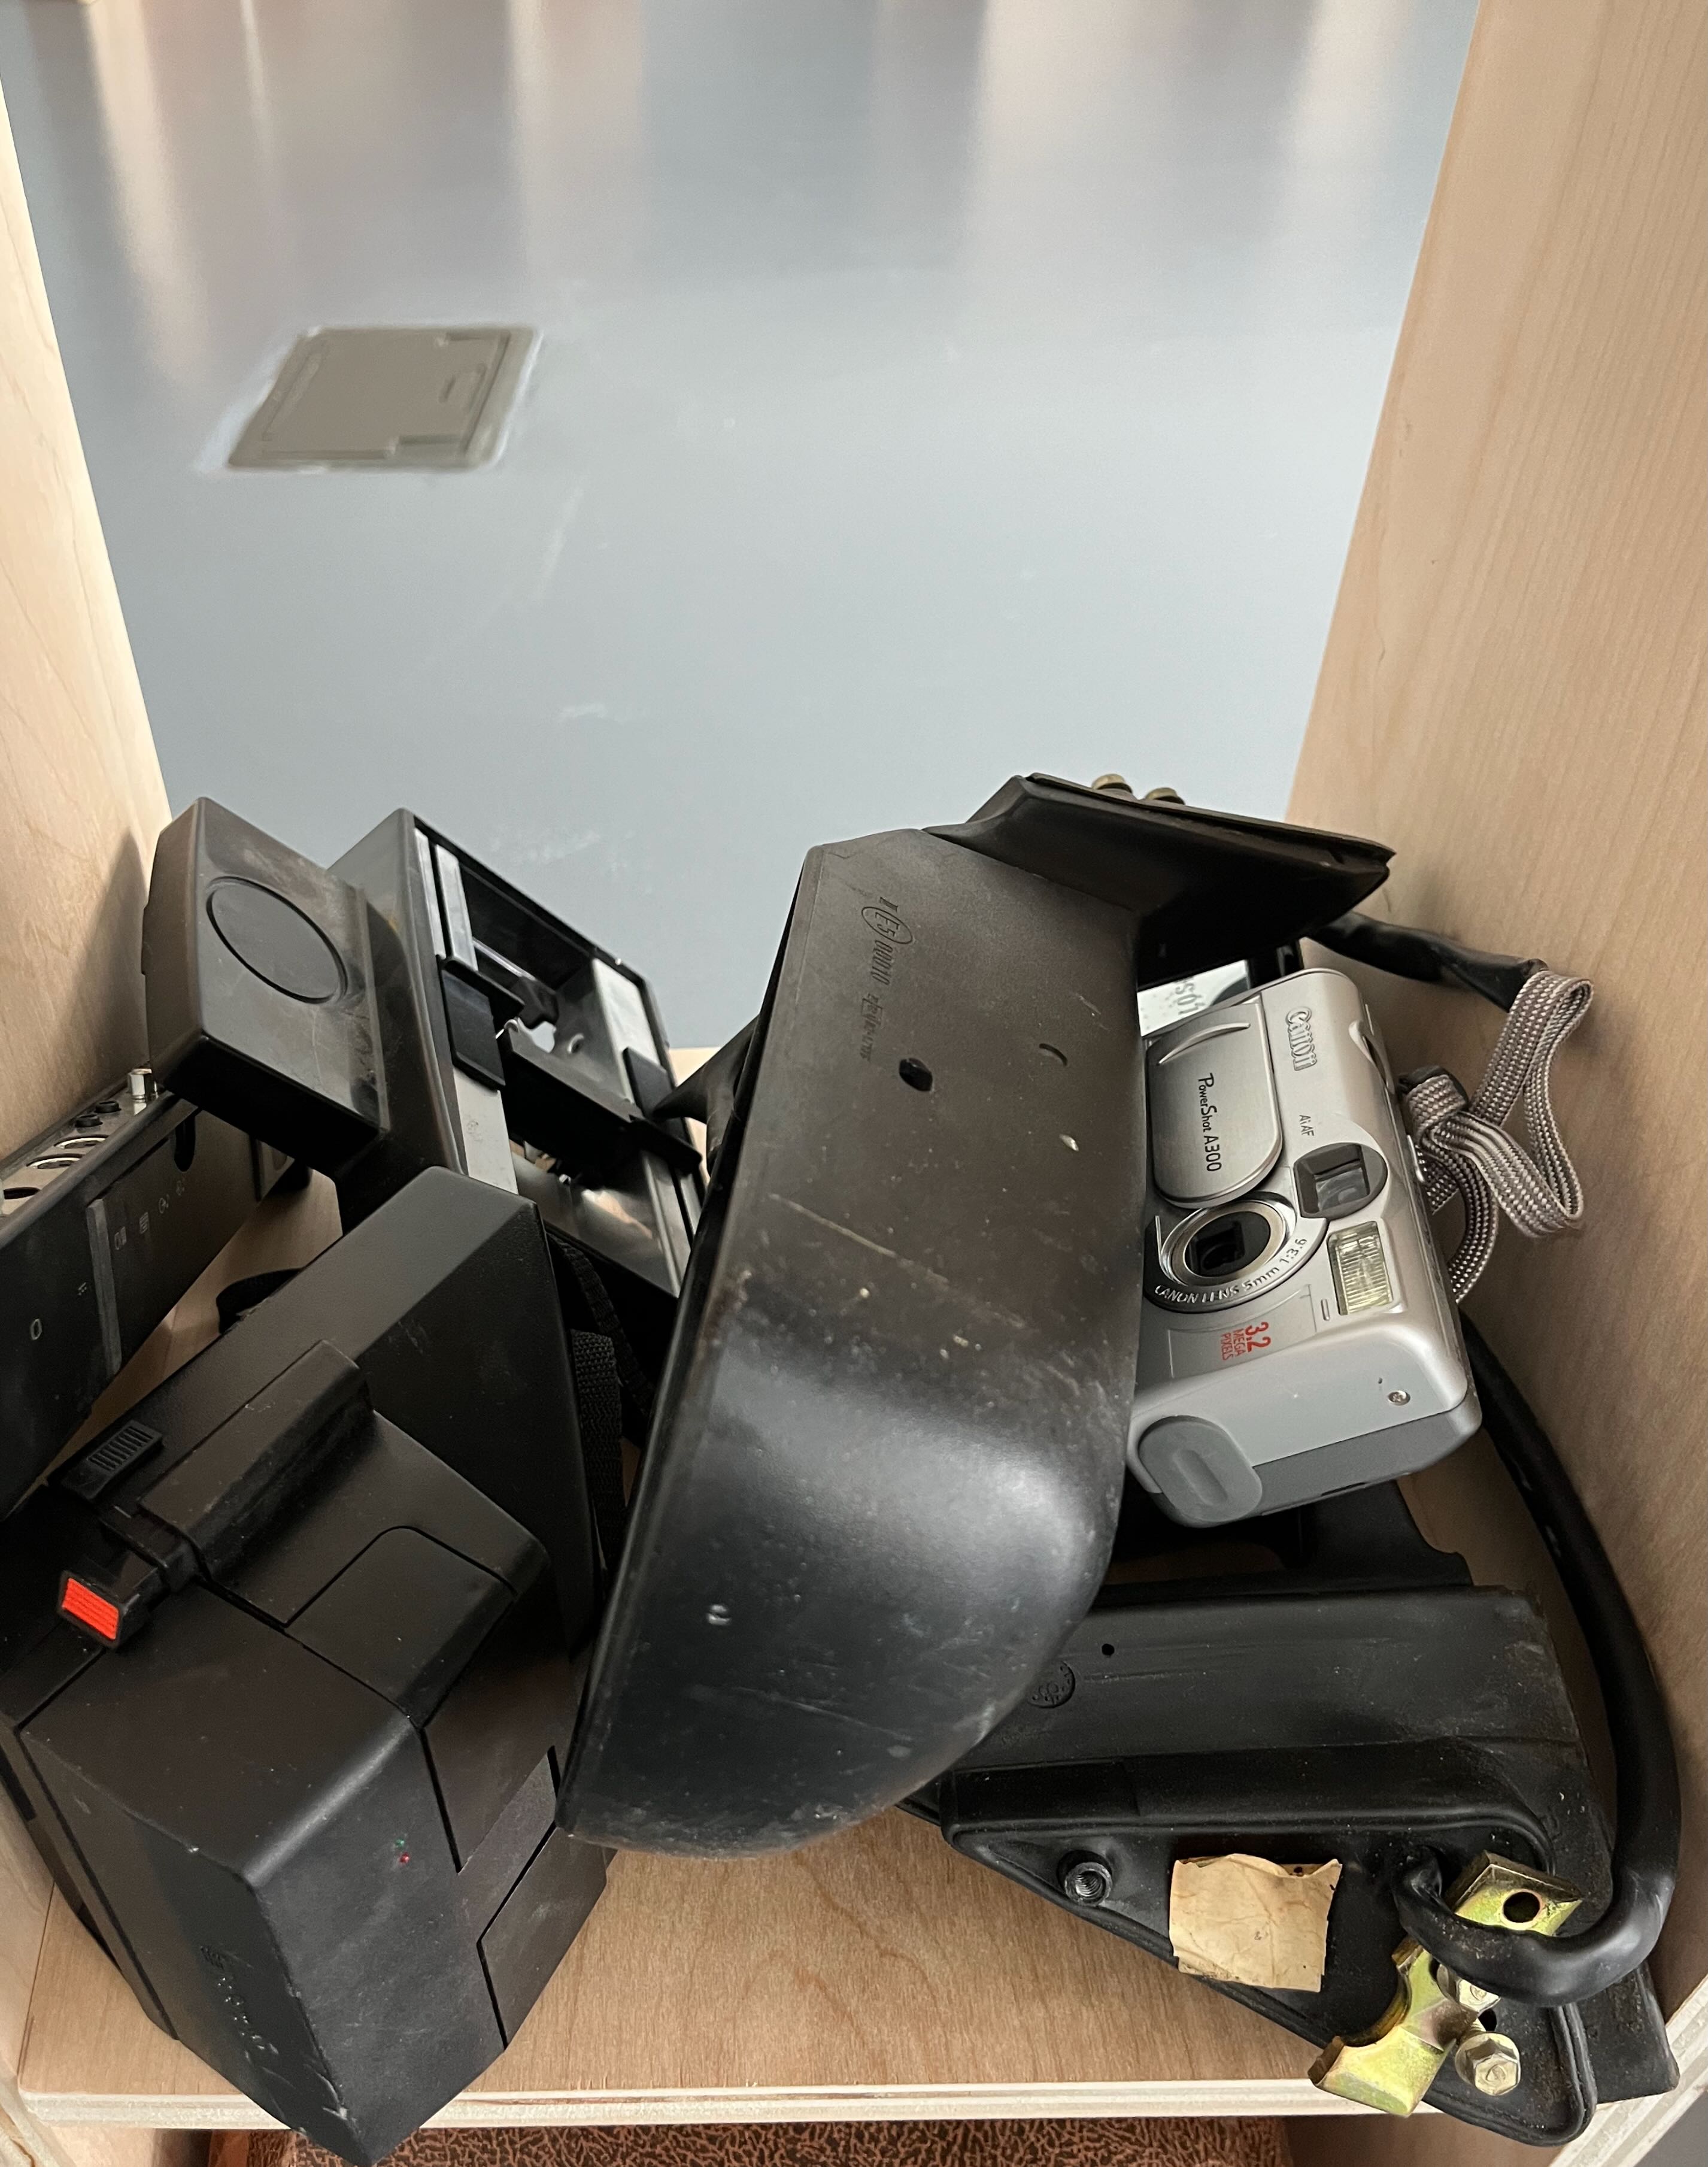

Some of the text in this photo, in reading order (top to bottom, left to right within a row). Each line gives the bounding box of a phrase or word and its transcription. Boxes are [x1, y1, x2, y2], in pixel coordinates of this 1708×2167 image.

[1286, 1007, 1317, 1071] Canon
[1198, 1072, 1222, 1171] PowerShot A300
[1155, 1238, 1307, 1304] CANON LENS 5mm 1:3.6
[1220, 1332, 1234, 1360] PIXELS
[1233, 1328, 1247, 1357] MEGA
[1245, 1322, 1272, 1353] 3.2
